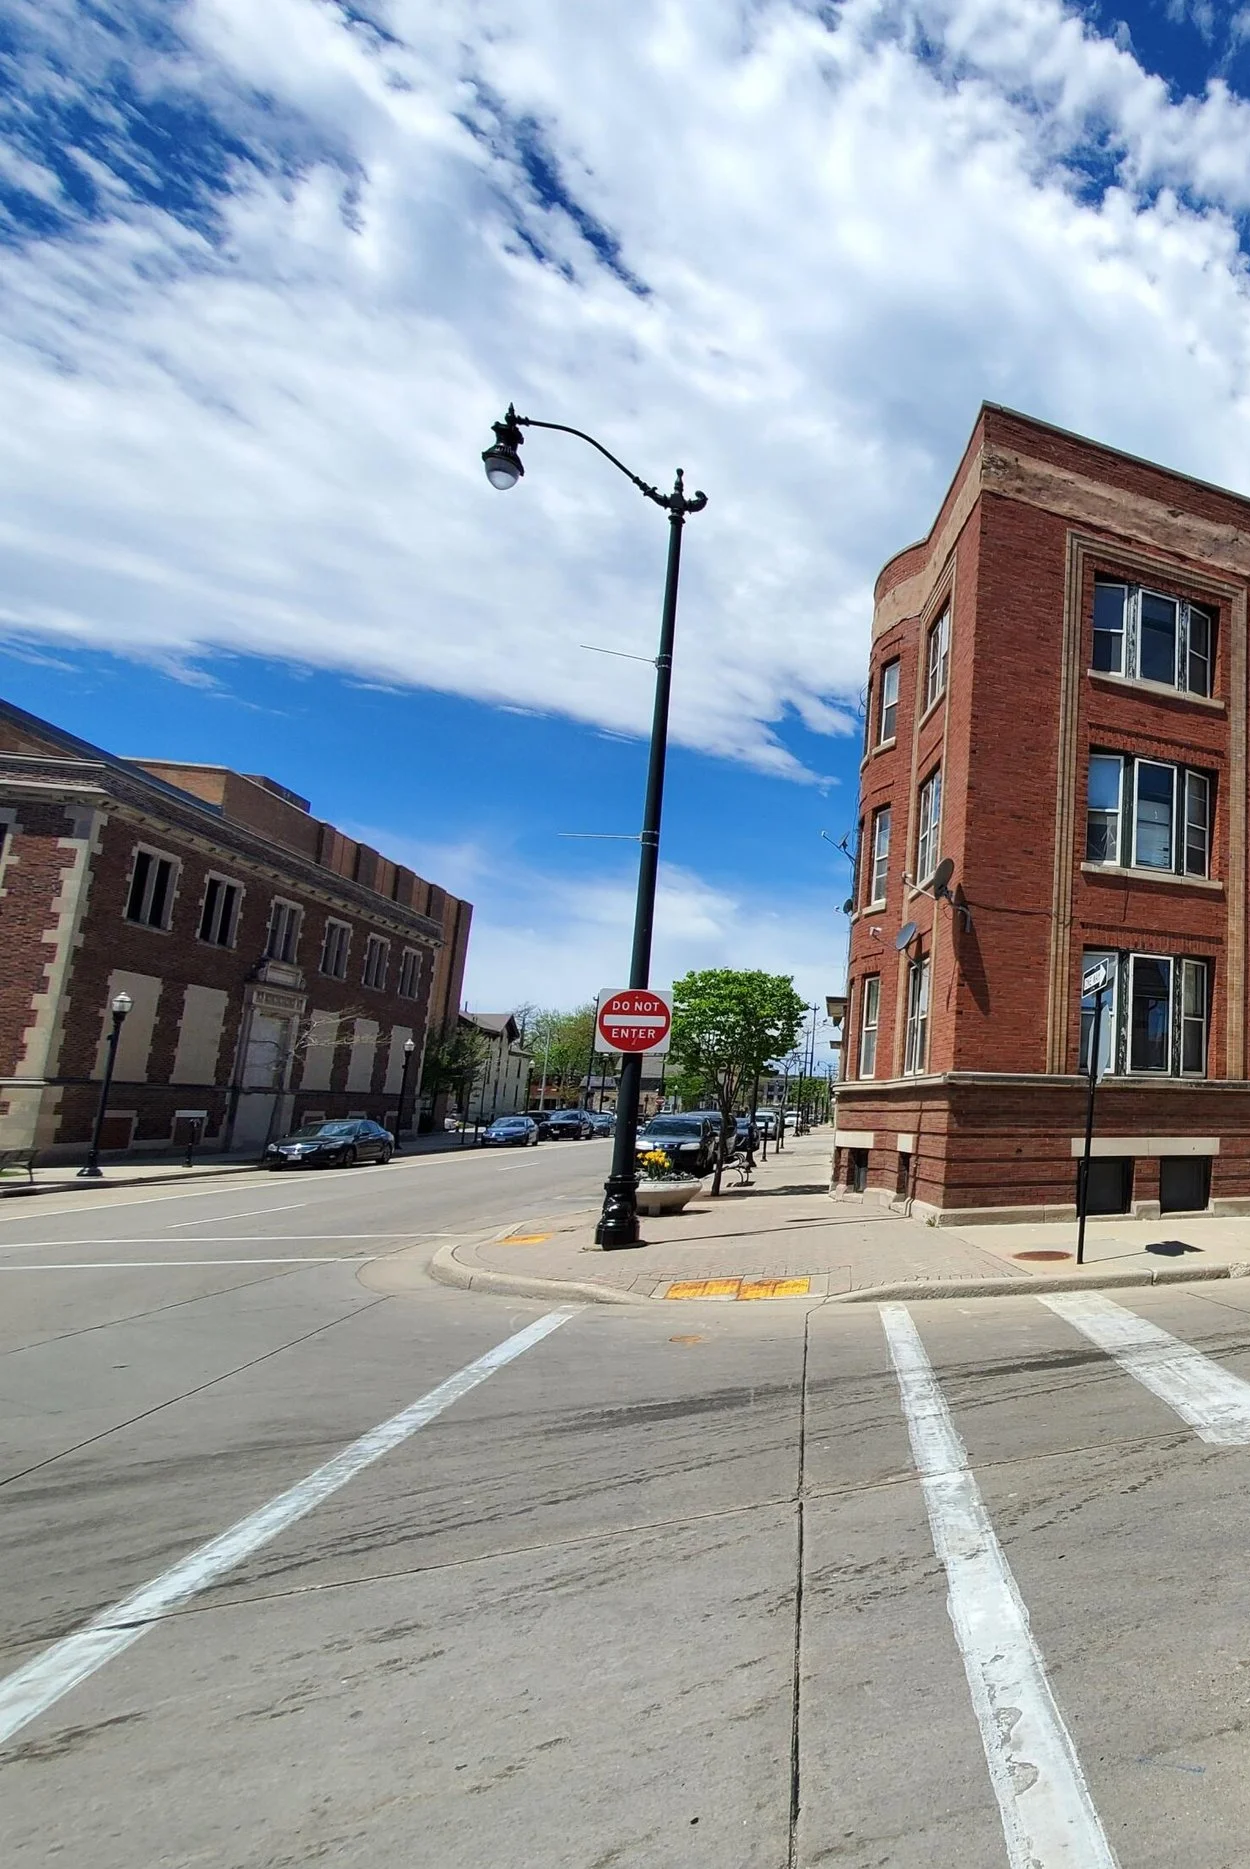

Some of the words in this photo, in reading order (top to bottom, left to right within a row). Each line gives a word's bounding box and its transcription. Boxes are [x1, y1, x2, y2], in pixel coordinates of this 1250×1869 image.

[612, 1001, 630, 1011] DO
[634, 1001, 660, 1012] NOT
[611, 1028, 656, 1039] ENTER
